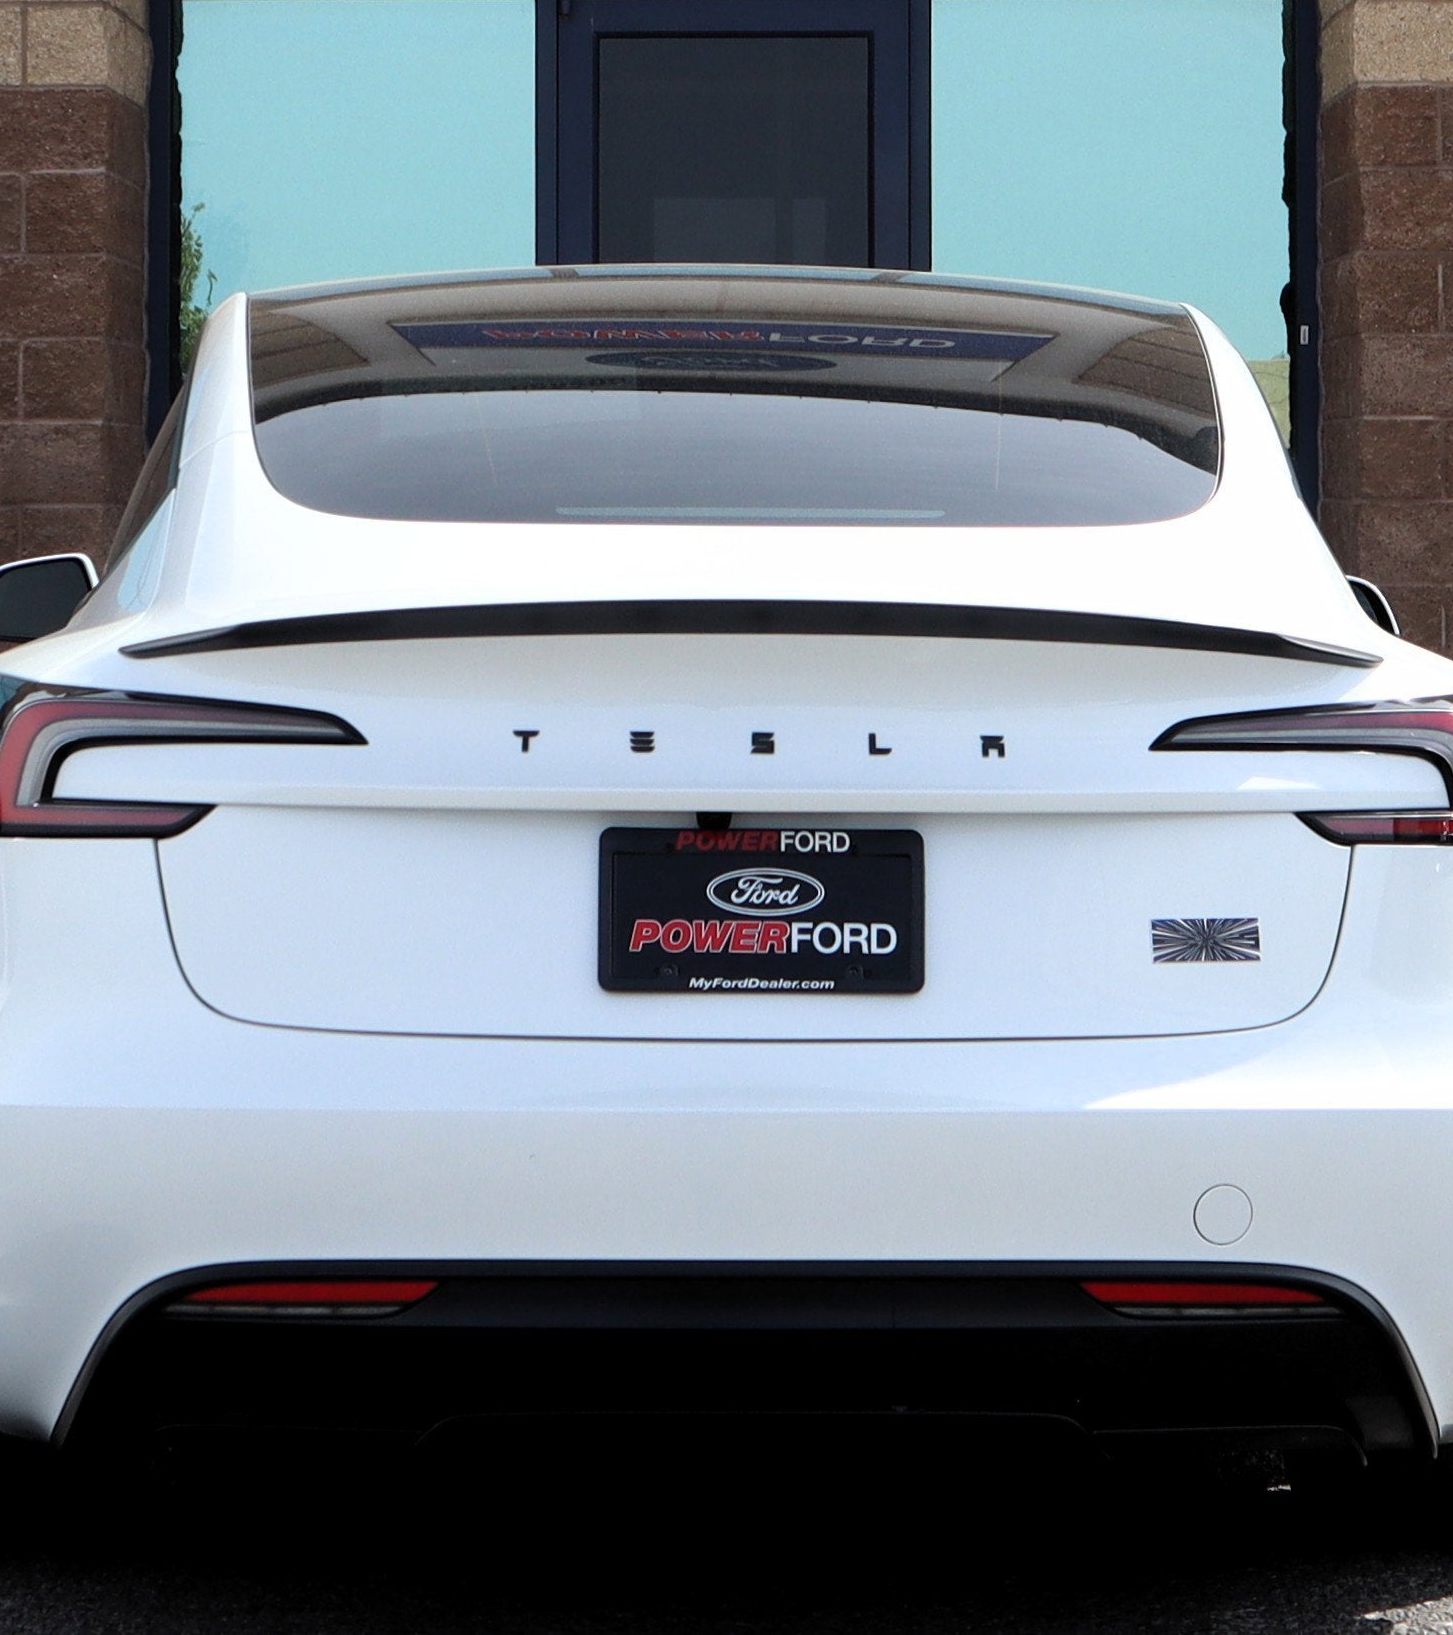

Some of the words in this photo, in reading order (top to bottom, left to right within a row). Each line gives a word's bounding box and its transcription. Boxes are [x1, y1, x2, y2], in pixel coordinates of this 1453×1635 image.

[512, 729, 1006, 758] TESLA
[730, 875, 801, 906] Ford
[628, 919, 898, 956] POWERFORD
[688, 977, 836, 992] MyFordDealer.com
